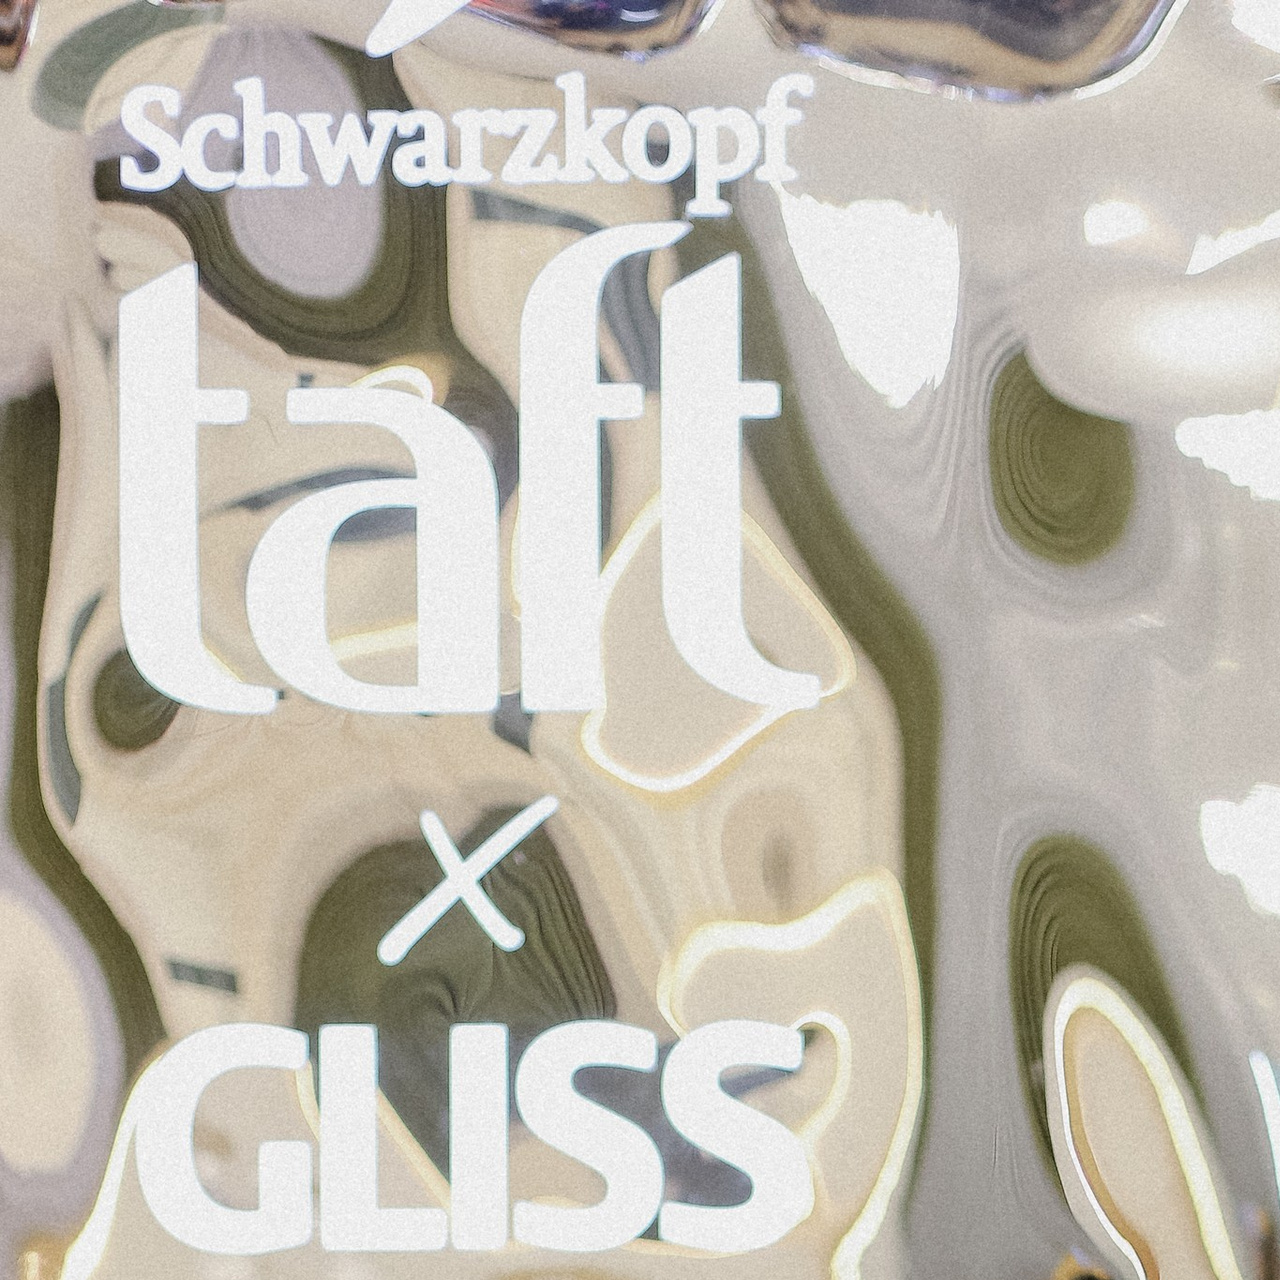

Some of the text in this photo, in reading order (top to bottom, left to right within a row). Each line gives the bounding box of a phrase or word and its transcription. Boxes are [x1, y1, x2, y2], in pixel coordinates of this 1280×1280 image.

[121, 73, 813, 215] Schwarzkopf
[119, 221, 821, 714] taft
[136, 1020, 815, 1254] GLISS
